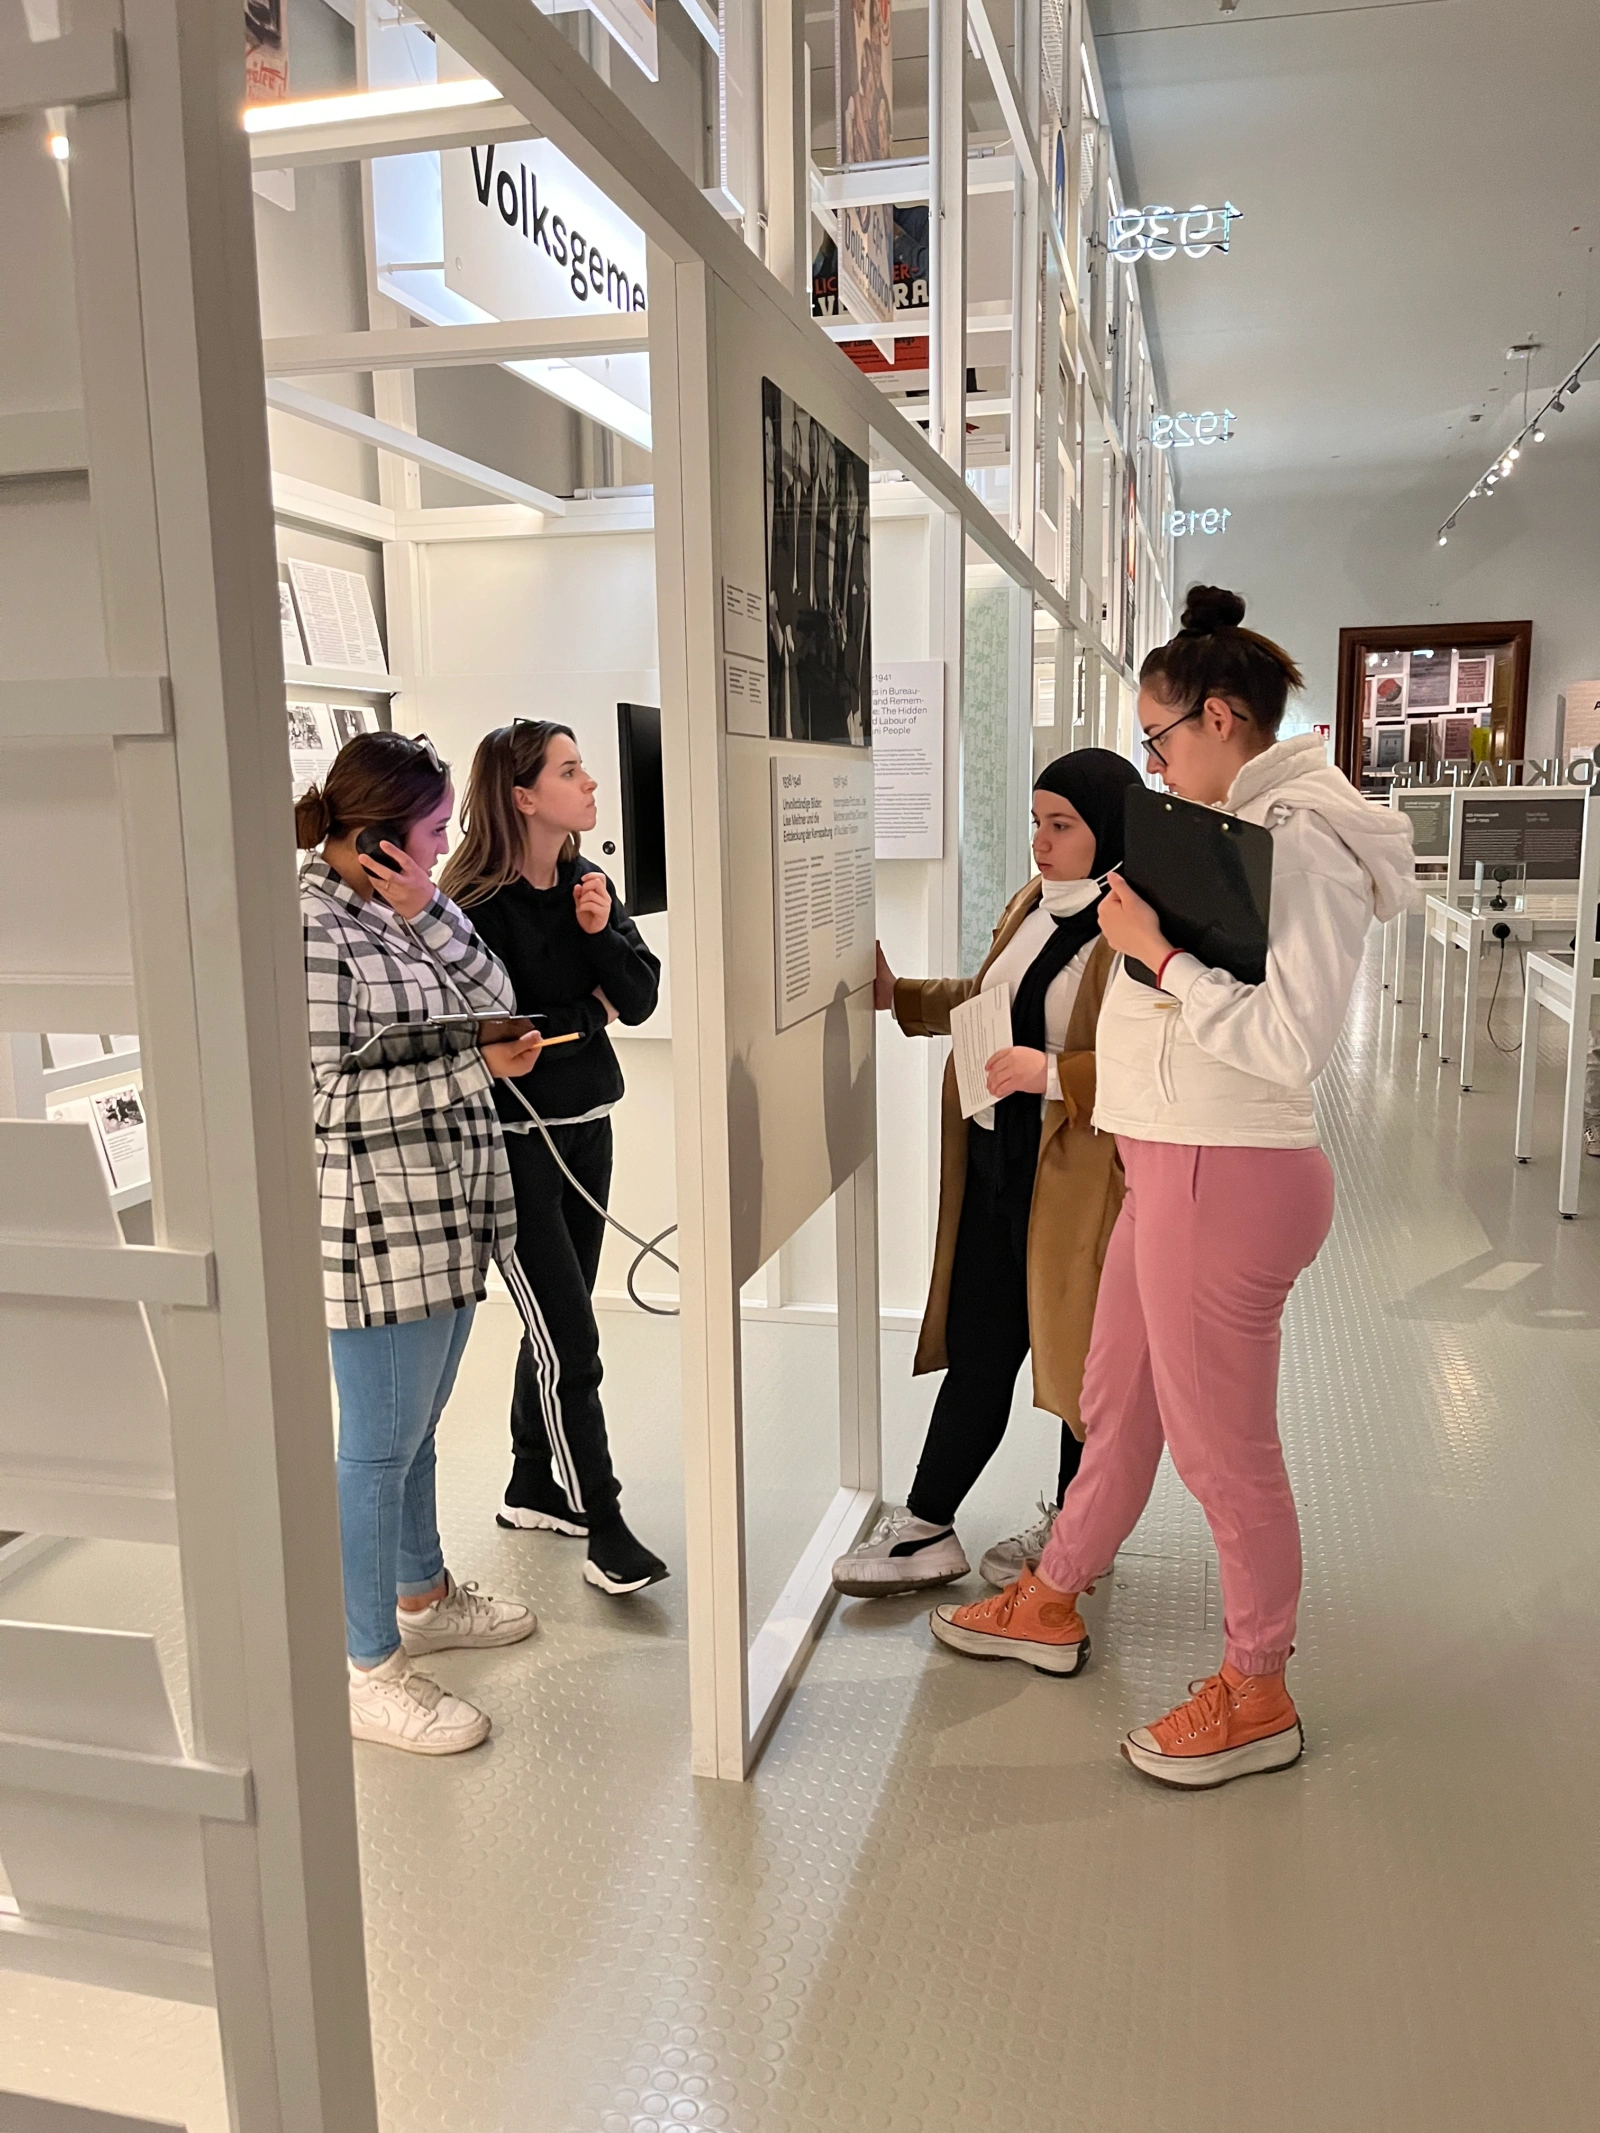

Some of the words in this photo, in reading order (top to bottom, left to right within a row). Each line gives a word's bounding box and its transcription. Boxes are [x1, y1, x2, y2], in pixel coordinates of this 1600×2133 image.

[889, 687, 920, 695] Bureau-
[873, 698, 888, 706] and
[889, 697, 925, 705] Remem-
[881, 707, 897, 715] The
[898, 706, 928, 714] Hidden
[879, 717, 907, 725] Labour
[908, 715, 917, 724] of
[883, 726, 911, 735] People
